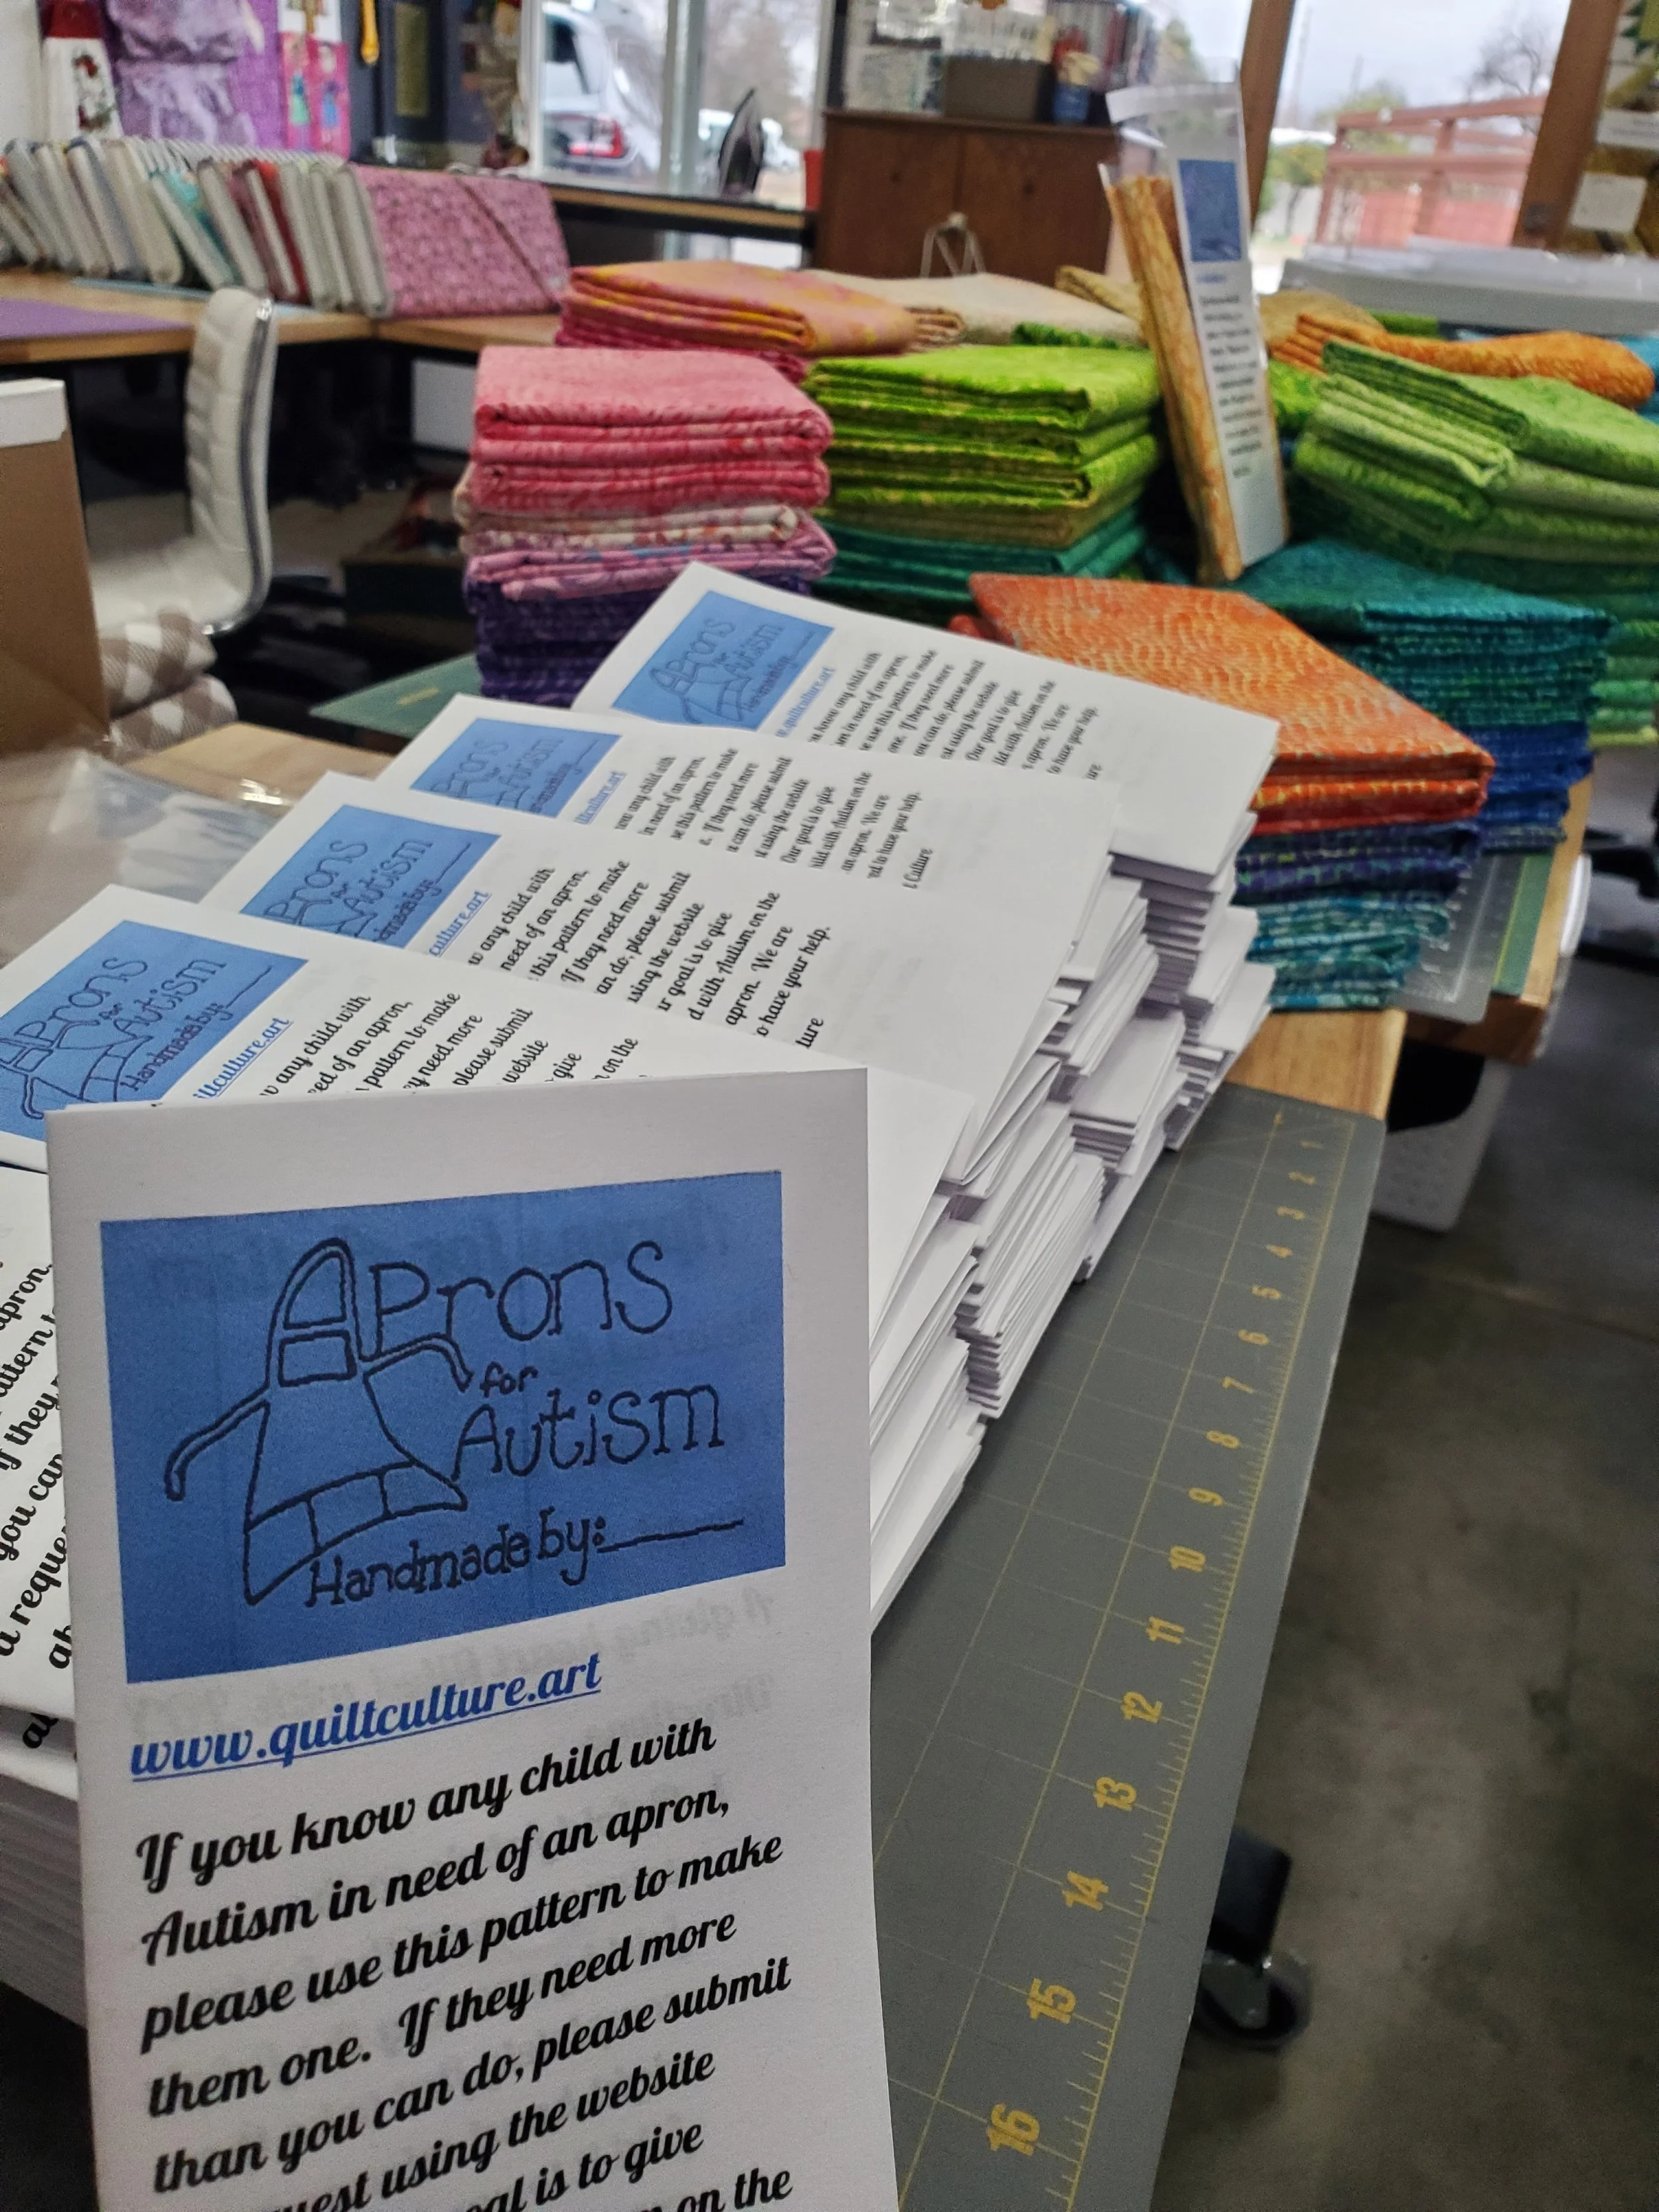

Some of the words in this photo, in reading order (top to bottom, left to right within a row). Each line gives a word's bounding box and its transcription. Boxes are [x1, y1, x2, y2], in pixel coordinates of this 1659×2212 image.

[479, 924, 510, 951] any
[500, 892, 533, 924] child
[525, 867, 555, 893] with
[498, 938, 532, 972] need
[524, 922, 545, 939] of
[536, 907, 557, 925] an
[550, 869, 590, 907] apron,
[528, 952, 558, 977] this
[550, 907, 594, 954] pattern
[583, 892, 603, 907] to
[597, 859, 630, 894] make
[618, 881, 649, 913] more
[748, 912, 768, 928] on
[755, 891, 780, 911] the
[428, 890, 492, 957] culture.art
[593, 976, 618, 995] an
[608, 954, 635, 975] do,
[624, 913, 662, 956] please
[654, 871, 691, 914] submit
[595, 911, 626, 943] need
[647, 947, 674, 968] the
[665, 902, 705, 947] website
[571, 942, 607, 971] they
[666, 964, 696, 997] goal
[682, 952, 704, 964] is
[693, 936, 713, 951] to
[706, 912, 733, 938] give
[715, 928, 757, 974] Autism
[113, 958, 227, 1039] Autism
[559, 967, 585, 983] If
[695, 976, 725, 1008] with
[724, 980, 762, 1026] apron.
[750, 948, 778, 972] We
[770, 925, 794, 948] are
[757, 989, 791, 1025] have
[782, 954, 809, 988] your
[797, 926, 831, 956] help.
[275, 1055, 314, 1084] any
[302, 1021, 343, 1055] child
[334, 995, 372, 1023] with
[330, 1054, 357, 1072] of
[345, 1039, 372, 1057] an
[364, 1001, 413, 1038] apron,
[362, 1039, 416, 1088] pattern
[403, 1023, 427, 1039] to
[420, 992, 461, 1026] make
[416, 1043, 455, 1076] need
[445, 1014, 483, 1046] more
[488, 1007, 534, 1049] submit
[610, 1037, 639, 1057] the
[794, 1017, 824, 1049] ture
[501, 1039, 549, 1083] website
[551, 1052, 582, 1079] give
[601, 1057, 624, 1074] on
[1250, 1284, 1281, 1301] 5
[1237, 1329, 1269, 1346] 6
[480, 1364, 539, 1398] for
[1222, 1376, 1254, 1394] 7
[452, 1384, 725, 1481] Autism
[1205, 1430, 1241, 1449] 8
[1188, 1487, 1226, 1507] 9
[9, 1526, 67, 1625] reque
[305, 1523, 529, 1607] Handmade
[1169, 1545, 1206, 1572] 10
[1146, 1616, 1186, 1645] 11
[129, 1653, 601, 1782] www.quiltculture.art
[1120, 1690, 1163, 1724] 12
[134, 1830, 184, 1895] If
[189, 1828, 282, 1887] you
[289, 1797, 416, 1856] know
[426, 1773, 513, 1822] any
[519, 1735, 622, 1797] child
[629, 1716, 717, 1769] with
[1093, 1775, 1138, 1812] 13
[139, 1898, 320, 1966] Autism
[327, 1878, 378, 1922] in
[384, 1840, 489, 1907] need
[494, 1823, 539, 1882] of
[541, 1820, 599, 1860] an
[605, 1788, 729, 1848] apron,
[1061, 1870, 1110, 1911] 14
[139, 1978, 297, 2055] please
[305, 1954, 384, 2004] use
[392, 1923, 474, 1978] this
[477, 1881, 626, 1963] pattern
[633, 1865, 675, 1901] to
[677, 1834, 783, 1889] make
[147, 2063, 271, 2118] them
[278, 2035, 372, 2087] one.
[396, 1996, 440, 2059] If
[444, 1976, 535, 2033] they
[540, 1934, 634, 2000] need
[639, 1913, 737, 1966] more
[1025, 1978, 1077, 2025] 15
[152, 2140, 269, 2195] than
[276, 2107, 366, 2175] you
[372, 2077, 455, 2130] can
[461, 2049, 524, 2097] do,
[531, 2003, 656, 2083] please
[662, 1955, 792, 2024] submit
[381, 2128, 500, 2199] using
[508, 2104, 568, 2146] the
[576, 2050, 715, 2122] website
[986, 2102, 1041, 2157] 16
[535, 2167, 570, 2205] is
[579, 2152, 620, 2189] to
[624, 2124, 704, 2183] give
[676, 2189, 725, 2212] on
[734, 2168, 793, 2210] the
